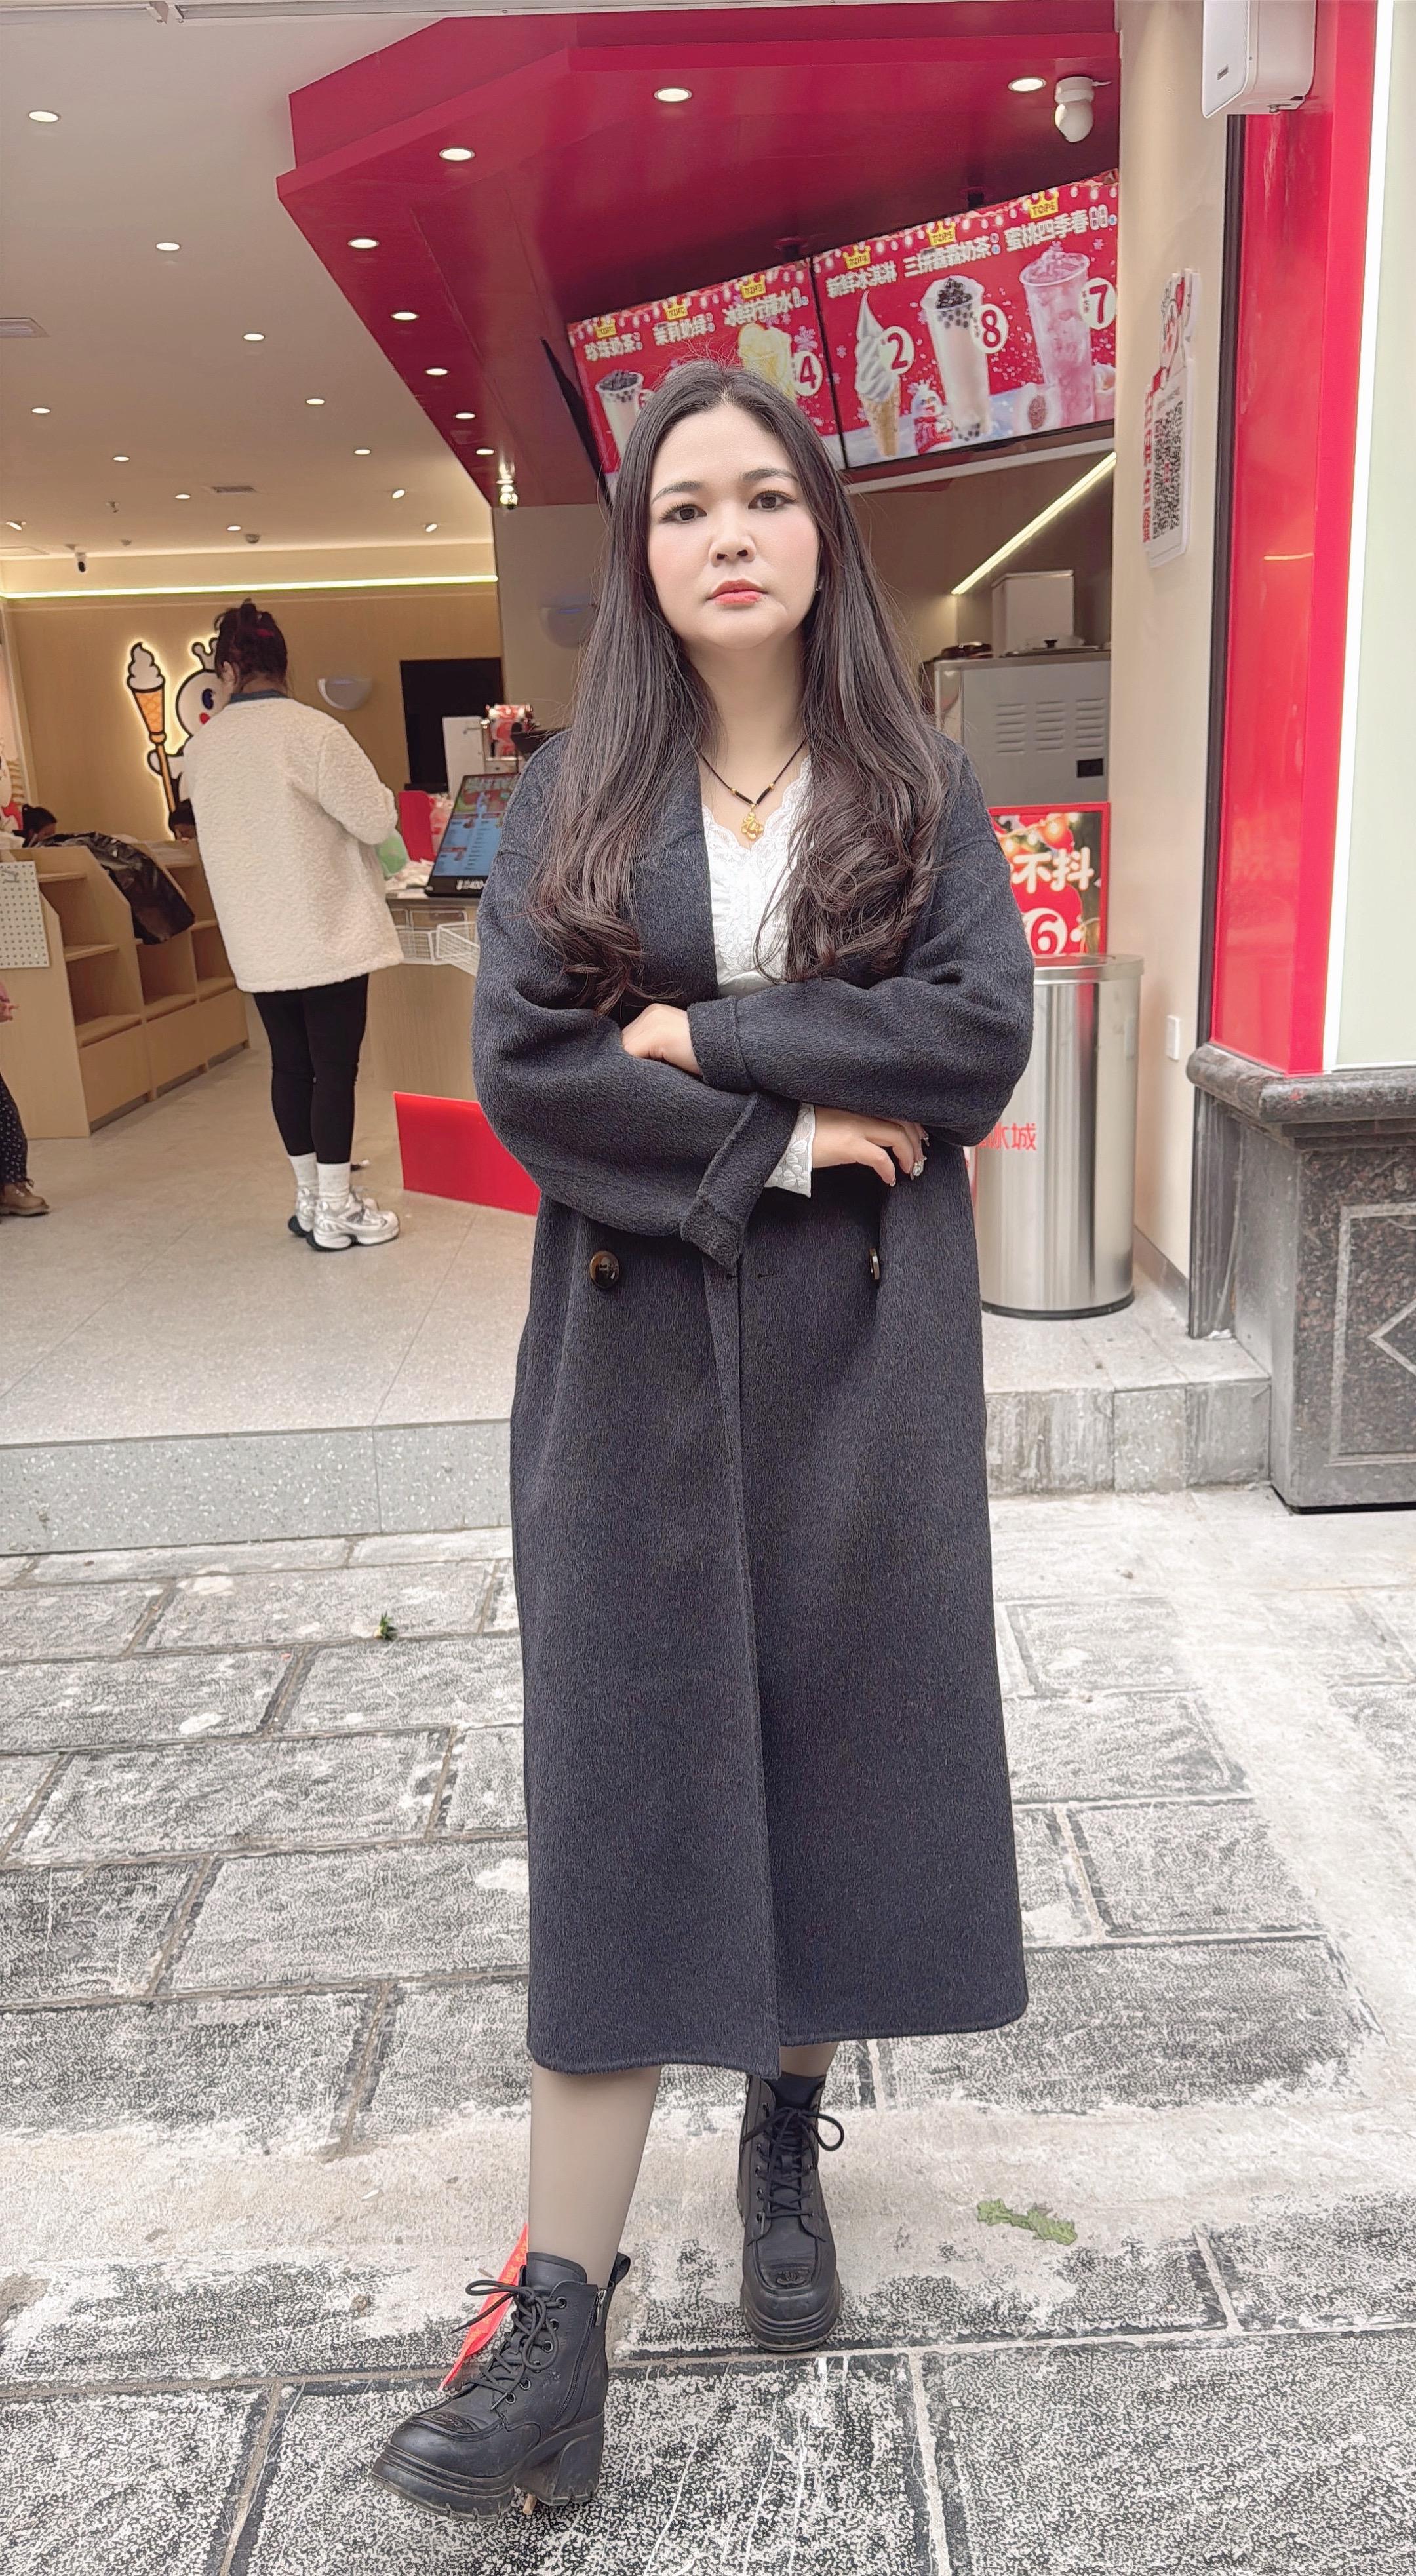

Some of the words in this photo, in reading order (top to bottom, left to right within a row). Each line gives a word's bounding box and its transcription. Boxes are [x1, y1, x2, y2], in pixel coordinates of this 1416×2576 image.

[1004, 209, 1089, 252] 蜜桃四季春
[1089, 284, 1108, 324] 7
[981, 309, 1001, 348] 8
[887, 332, 909, 370] 2
[800, 356, 816, 389] 4
[1010, 846, 1095, 894] 不抖
[1031, 913, 1059, 955] 6
